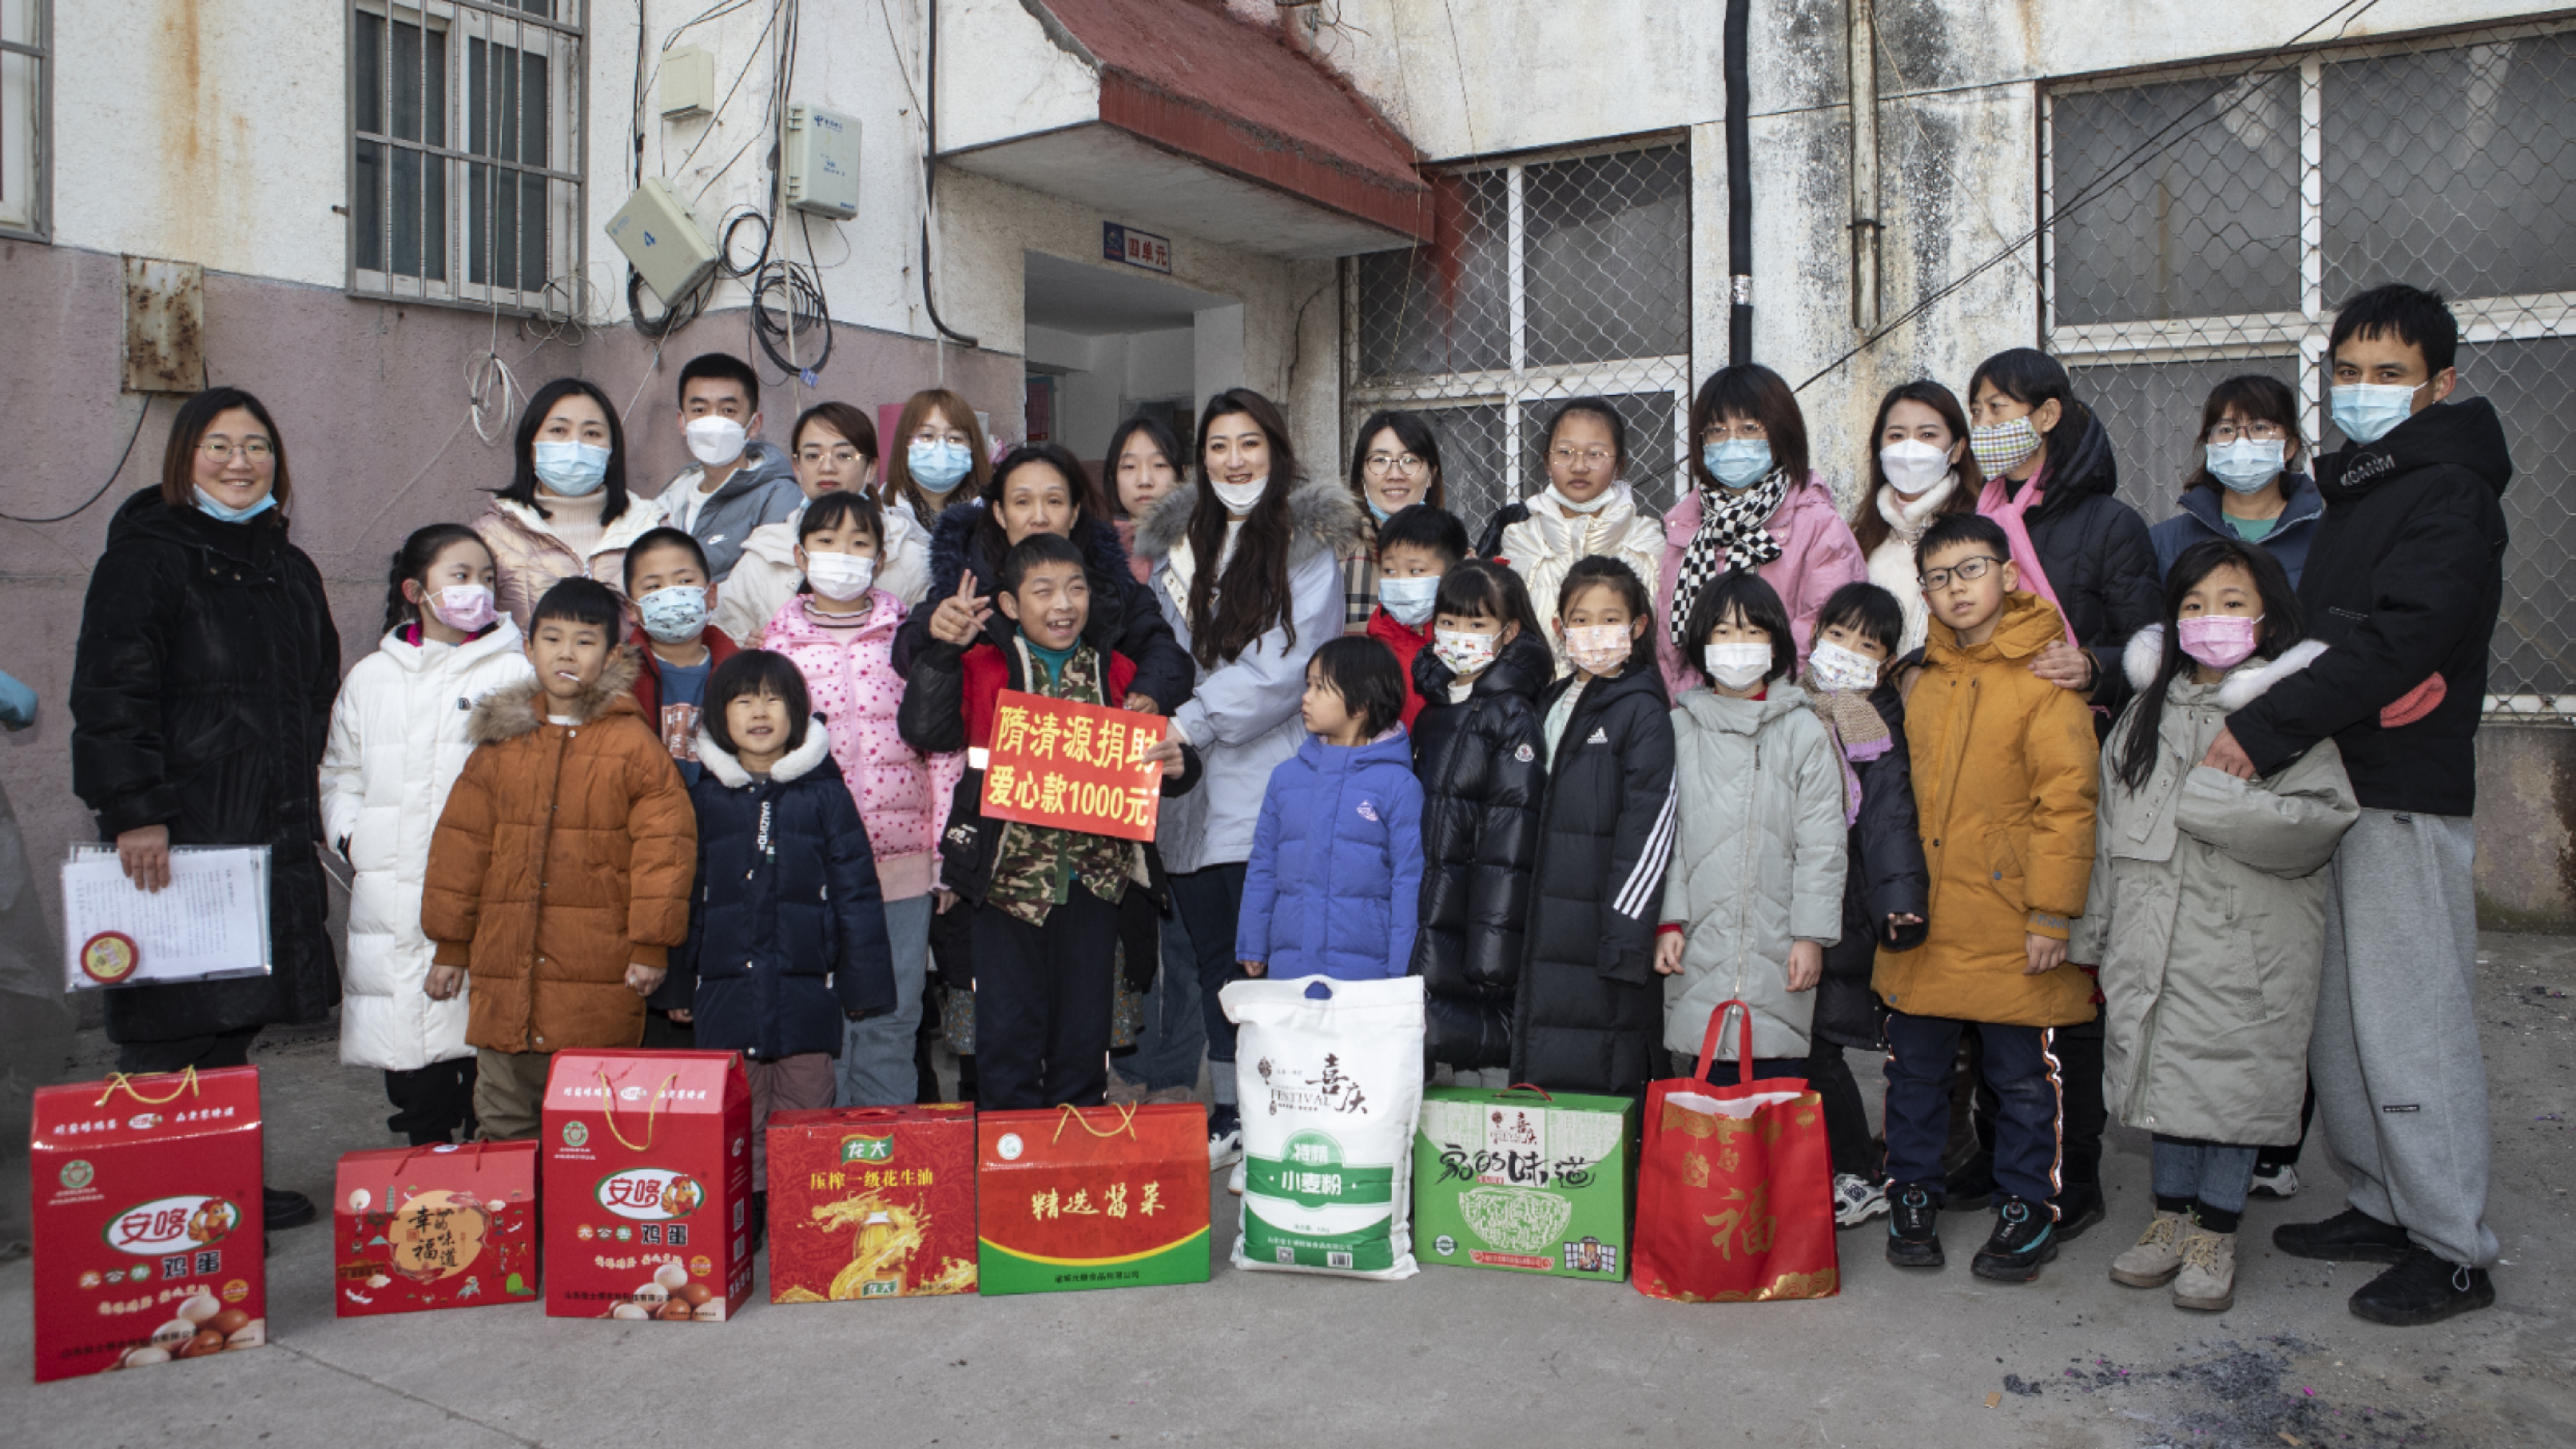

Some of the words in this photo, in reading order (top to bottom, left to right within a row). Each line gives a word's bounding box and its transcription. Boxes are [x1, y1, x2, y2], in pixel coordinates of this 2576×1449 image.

[644, 230, 656, 247] 4
[1128, 238, 1167, 266] 四单元
[996, 706, 1159, 774] 隋清源捐助
[988, 765, 1151, 826] 爱心款1000元
[849, 1141, 887, 1158] 龙大
[811, 1168, 933, 1190] 压榨一级花生油
[1281, 1171, 1342, 1196] 小麦粉
[1702, 1179, 1778, 1261] 福
[641, 1224, 688, 1246] 鸡蛋
[162, 1250, 221, 1280] 鸡蛋
